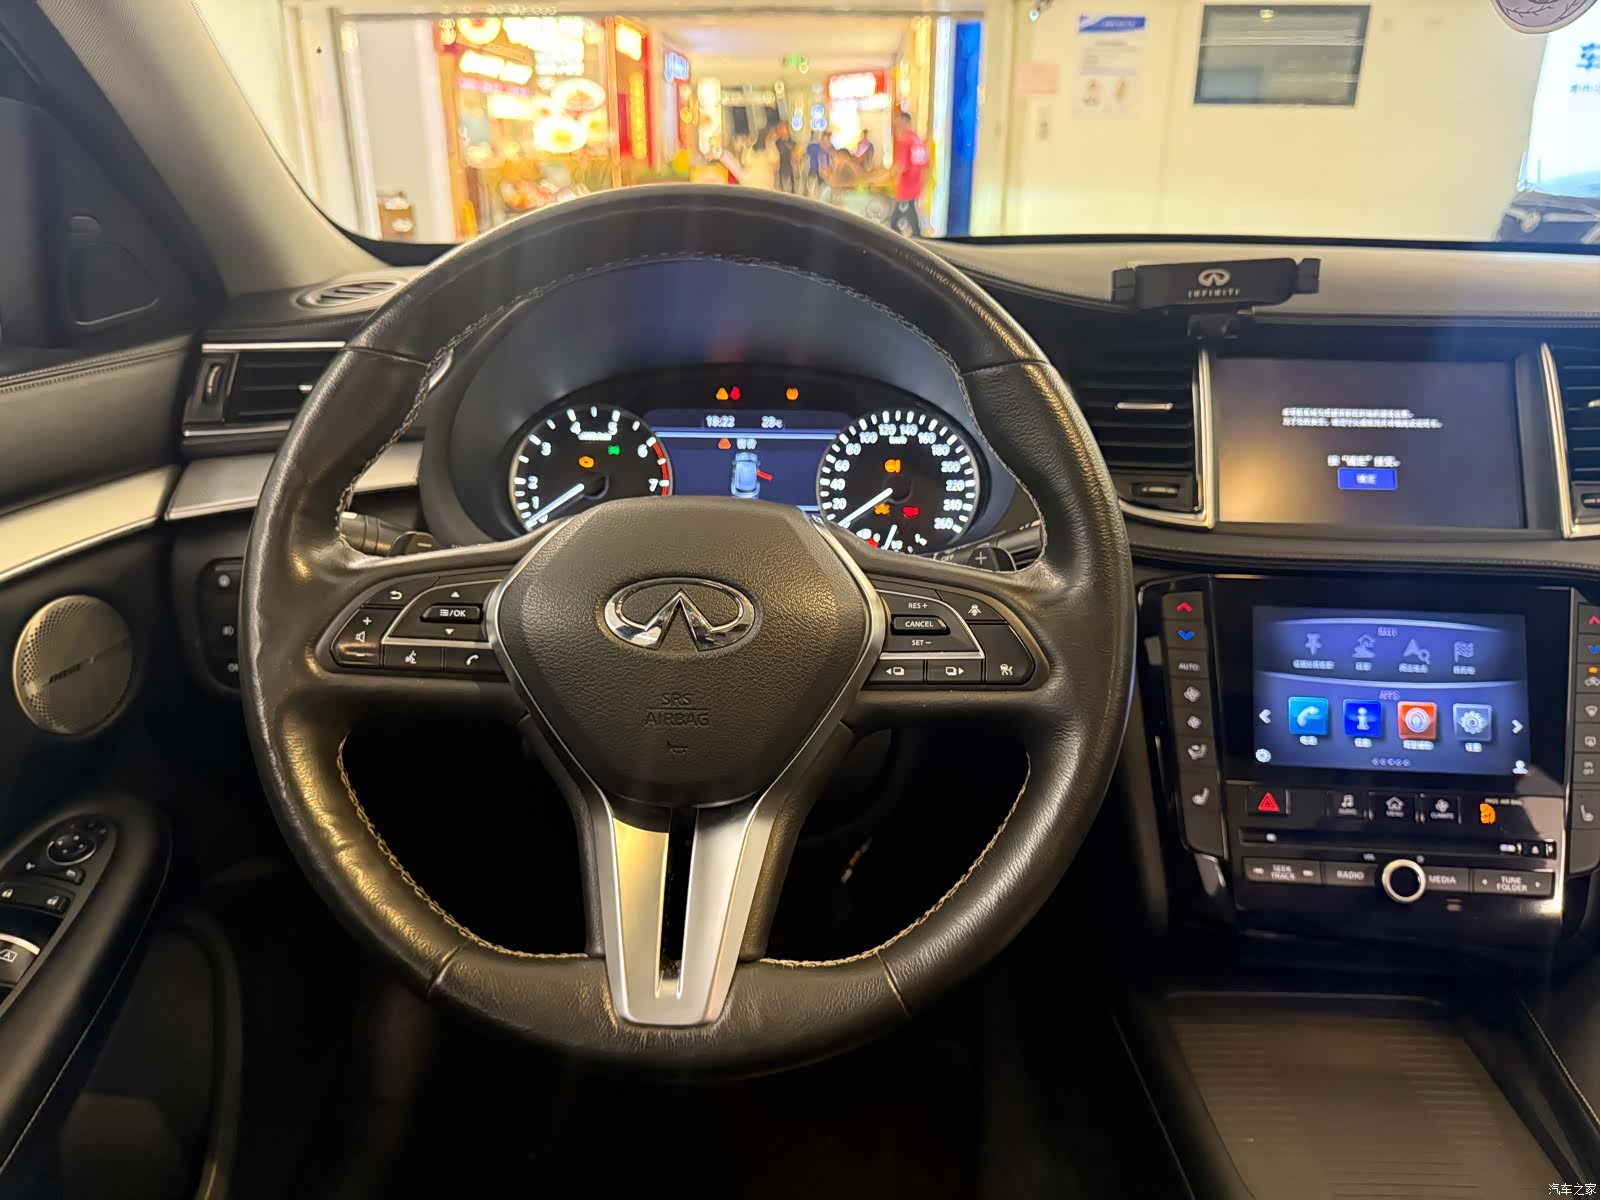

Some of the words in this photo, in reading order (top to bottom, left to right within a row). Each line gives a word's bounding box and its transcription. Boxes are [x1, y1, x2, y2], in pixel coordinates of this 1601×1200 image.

[570, 421, 581, 434] 4
[608, 421, 618, 435] 5
[878, 424, 896, 436] 120
[900, 424, 918, 436] 140
[859, 431, 878, 444] 100
[918, 432, 936, 444] 160
[541, 441, 551, 455] 3
[637, 444, 648, 458] 6
[846, 443, 861, 455] 80
[931, 444, 950, 456] 180
[834, 460, 850, 472] 60
[941, 461, 961, 473] 200
[528, 475, 538, 489] 2
[649, 478, 658, 492] 7
[830, 478, 845, 490] 40
[946, 480, 965, 491] 220
[532, 496, 539, 509] 1
[832, 498, 847, 510] 20
[943, 499, 962, 511] 240
[934, 517, 953, 529] 260
[905, 620, 933, 628] CANCEL
[661, 692, 690, 706] SRS
[643, 712, 709, 727] AIRBAG
[1336, 870, 1365, 880] RADIO
[1428, 875, 1456, 884] MEDIA
[1501, 875, 1521, 884] TUNE
[1496, 883, 1527, 892] FOLDER
